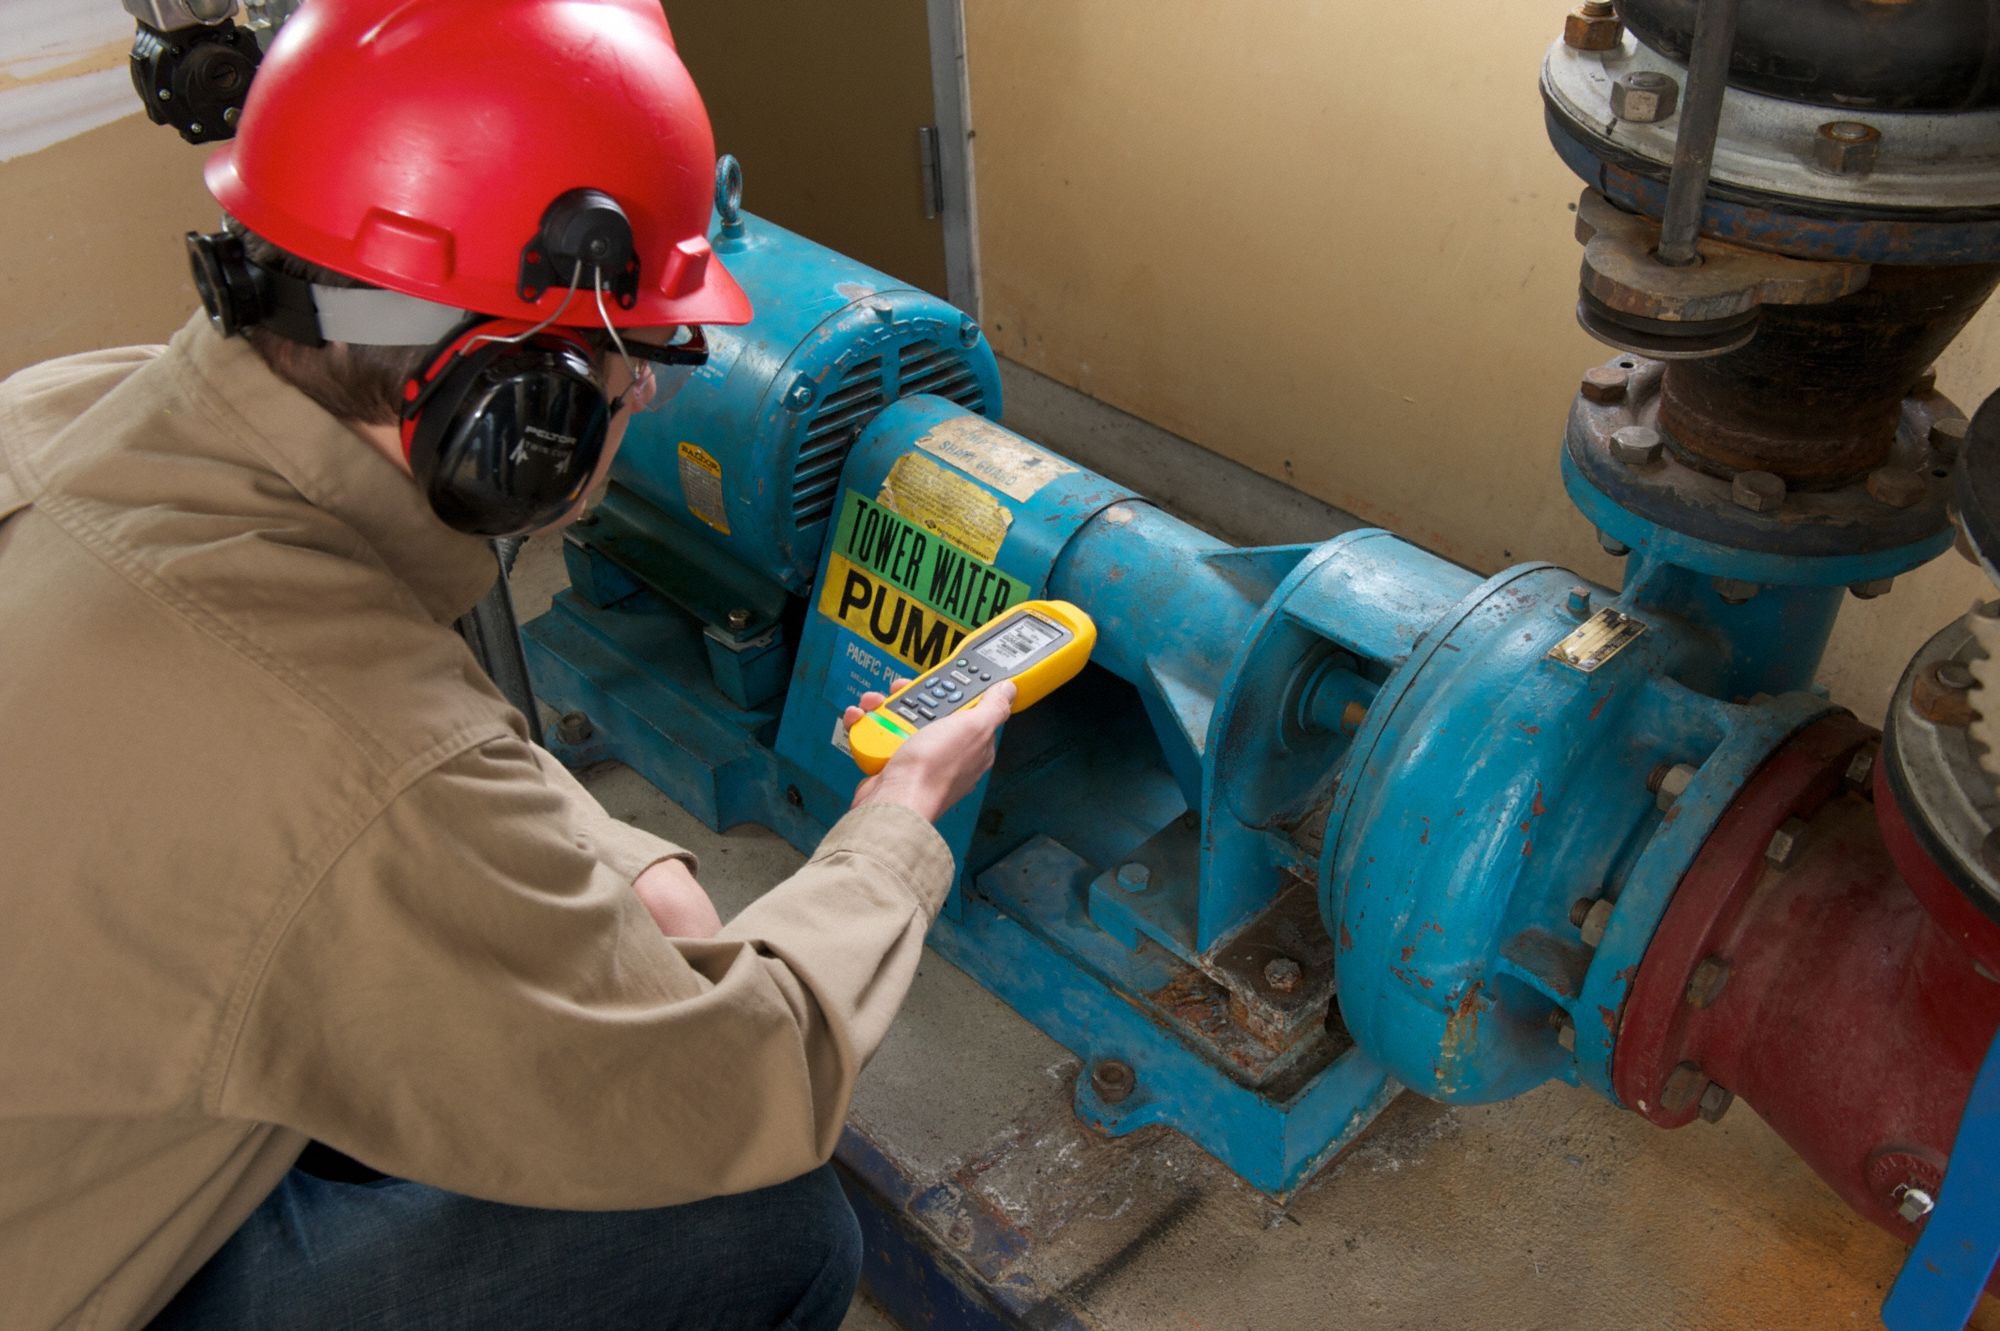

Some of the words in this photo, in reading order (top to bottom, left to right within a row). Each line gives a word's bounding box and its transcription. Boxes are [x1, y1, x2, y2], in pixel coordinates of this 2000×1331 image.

[848, 499, 927, 591] TOWER
[928, 544, 1012, 628] WATER
[846, 642, 882, 676] PACIFIC
